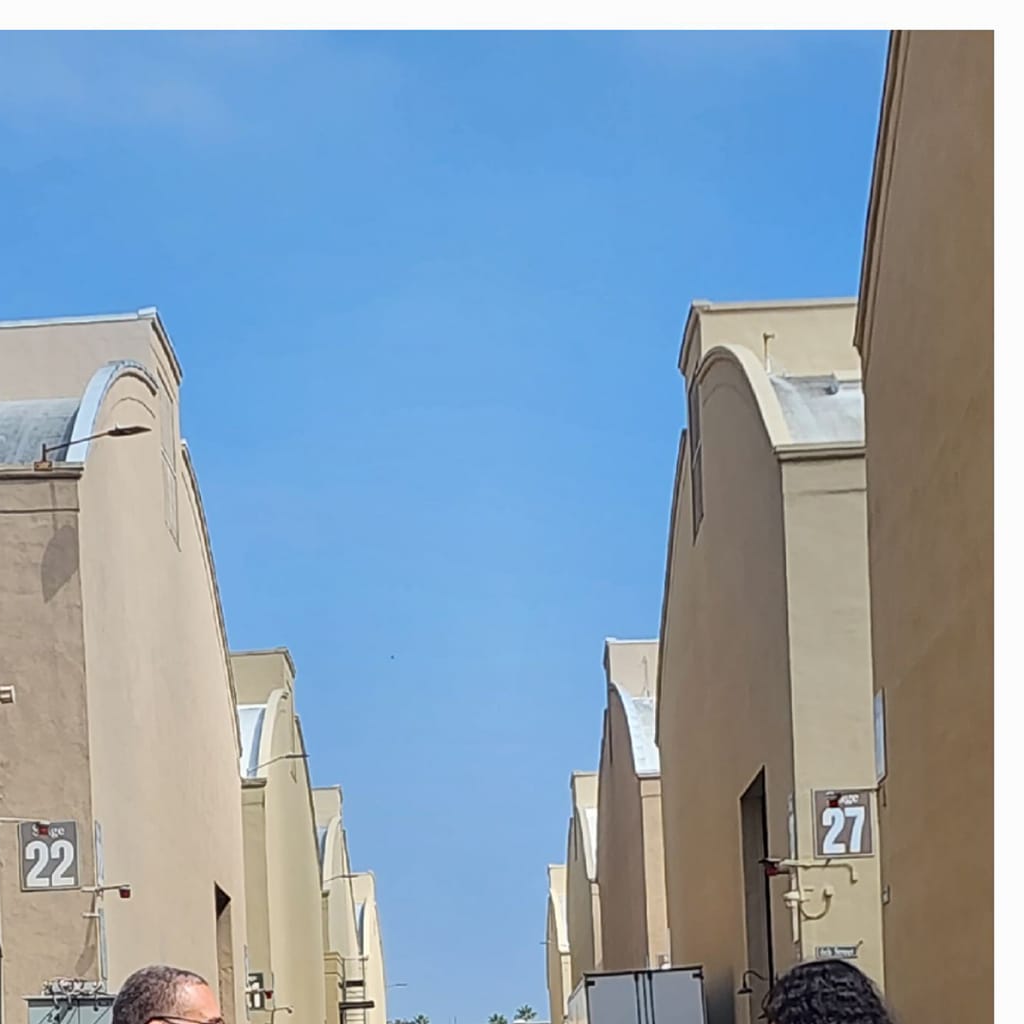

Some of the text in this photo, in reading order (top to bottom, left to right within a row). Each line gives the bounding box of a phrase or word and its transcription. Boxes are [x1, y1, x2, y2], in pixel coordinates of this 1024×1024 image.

[32, 823, 64, 839] Sge
[822, 806, 865, 854] 27
[25, 840, 75, 887] 22
